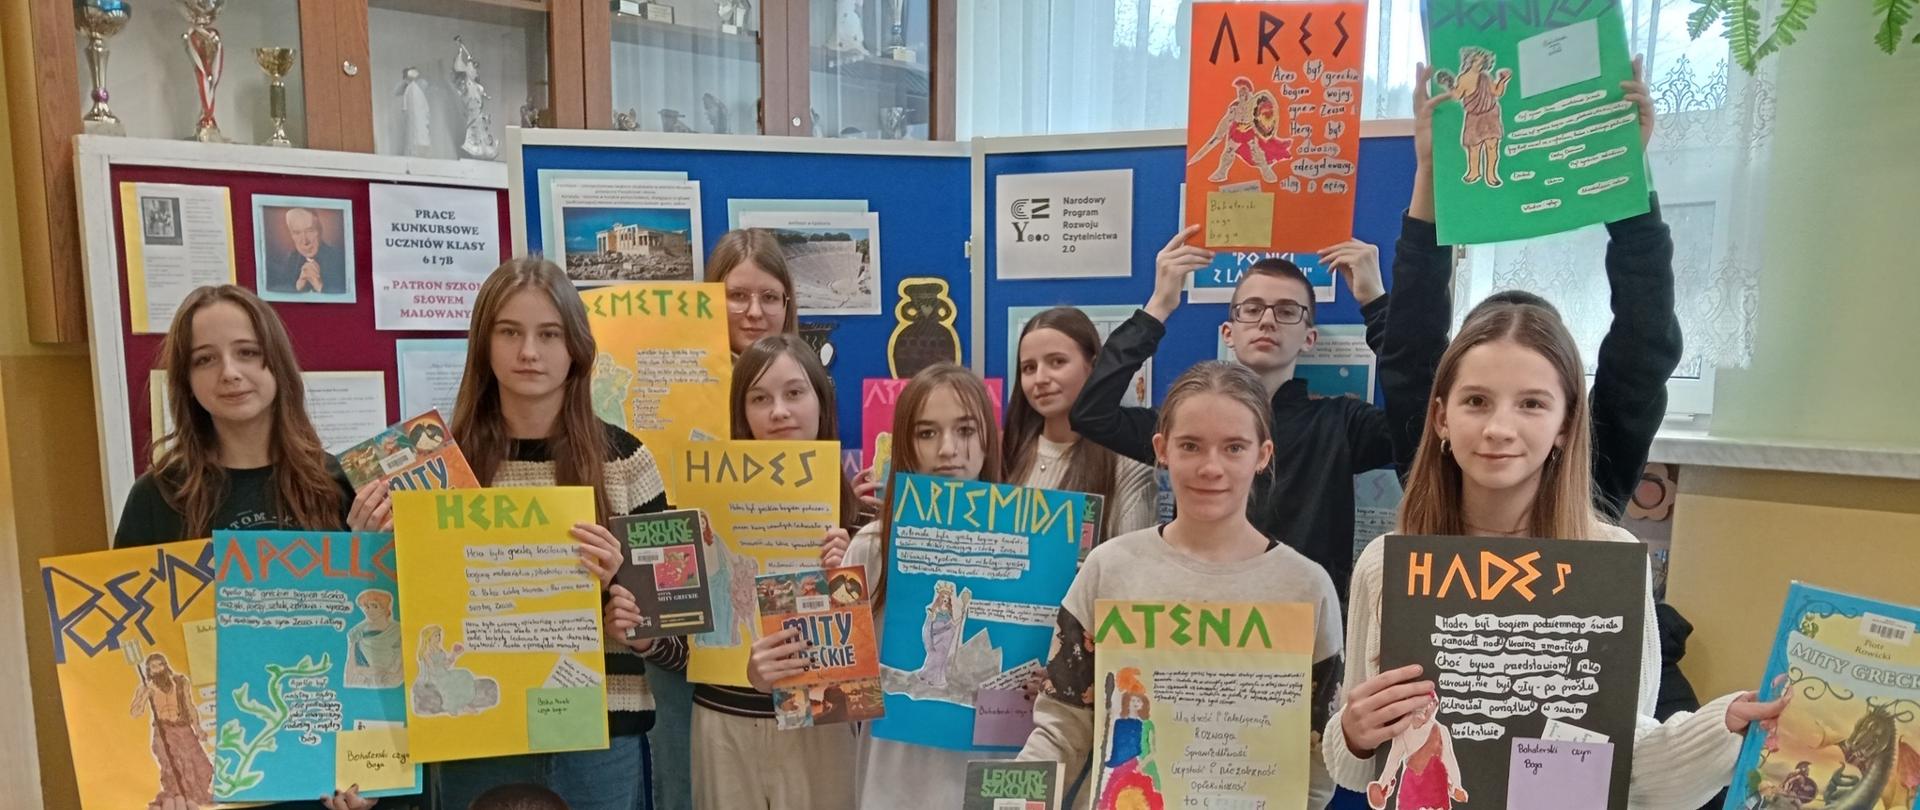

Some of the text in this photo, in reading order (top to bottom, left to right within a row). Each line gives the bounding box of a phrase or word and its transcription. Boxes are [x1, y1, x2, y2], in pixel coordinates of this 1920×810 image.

[1208, 10, 1349, 65] ARES
[1273, 65, 1295, 81] Ares
[1063, 197, 1106, 205] Narodowy
[414, 209, 456, 220] PRACE
[1063, 209, 1099, 218] Program
[391, 222, 480, 236] KUNKURSOWE
[1062, 221, 1099, 230] Rozwoju
[385, 238, 486, 251] UCZNIÓW KLASY
[1062, 233, 1118, 242] Czytelnictwa
[1062, 245, 1076, 253] 2.0
[422, 256, 430, 264] 6
[439, 256, 454, 265] 7B
[392, 280, 443, 291] PATRON
[413, 295, 464, 305] SŁOWEM
[585, 289, 713, 319] EMETER
[400, 309, 471, 319] MALOWANY
[686, 450, 816, 488] HADES
[435, 494, 549, 531] HERA
[894, 476, 1075, 543] ARTEMIDA
[626, 517, 691, 535] LEKTURY
[628, 530, 694, 548] SZKOLNE
[1407, 551, 1572, 602] HADES
[783, 612, 851, 646] MITY
[1095, 603, 1273, 649] ATENA
[1442, 617, 1619, 634] Hades był bogiem podziemnego świata
[1441, 635, 1479, 649] panował
[1864, 639, 1885, 651] Piotr
[1436, 654, 1462, 668] Choć
[1469, 658, 1495, 675] bywa
[1579, 658, 1600, 672] jako
[1792, 643, 1849, 674] MITY
[1544, 683, 1556, 694] po
[1517, 743, 1558, 755] Bohaterski
[1524, 758, 1543, 775] Boga
[983, 768, 1048, 784] LEKTURY
[981, 783, 1048, 800] SZKOLNE
